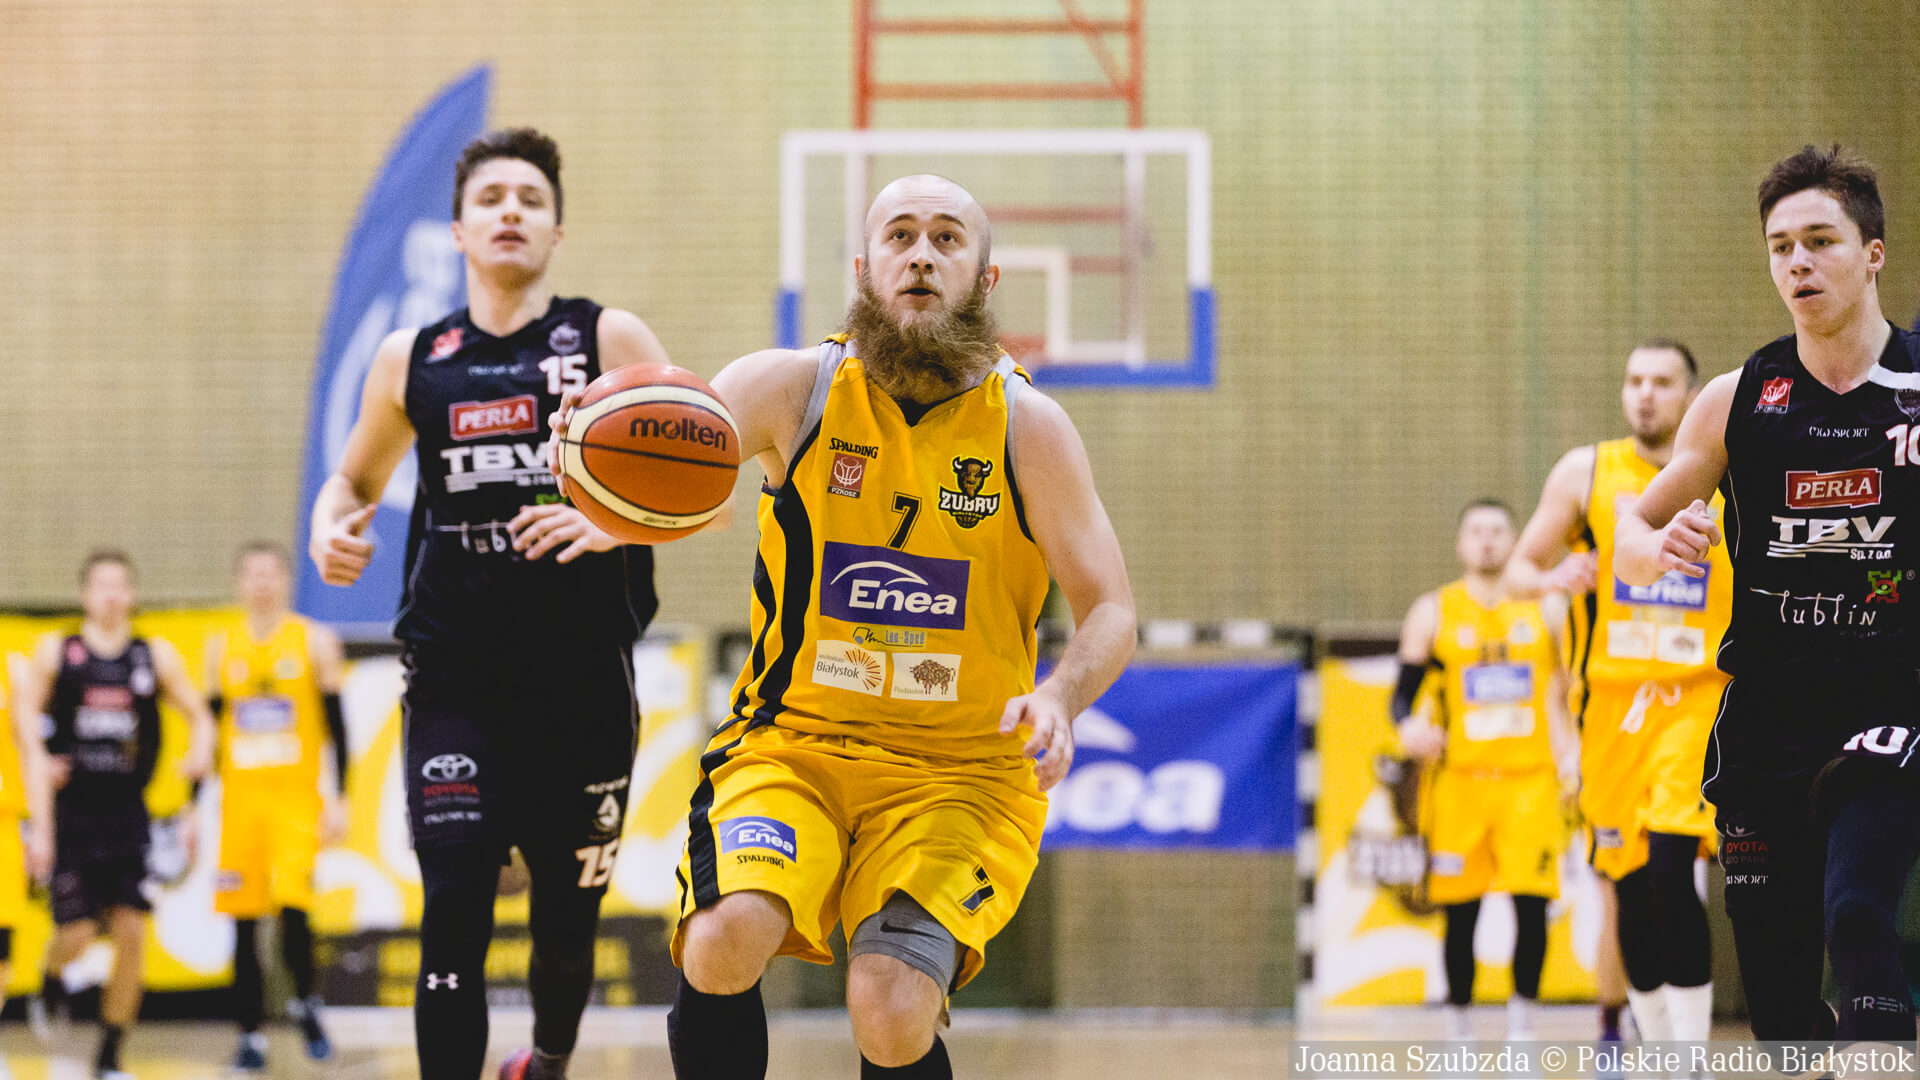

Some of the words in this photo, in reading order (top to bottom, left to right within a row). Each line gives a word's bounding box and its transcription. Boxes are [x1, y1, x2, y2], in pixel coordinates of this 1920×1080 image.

[538, 353, 588, 395] 15
[457, 403, 530, 432] PERŁA
[629, 417, 727, 452] molten
[829, 437, 880, 460] SPALDING
[440, 443, 550, 473] TBV
[940, 490, 998, 514] ZUBRY
[1795, 476, 1873, 500] PERŁA
[886, 491, 922, 552] 7
[1771, 515, 1896, 543] TBV
[848, 578, 957, 615] Enea
[816, 661, 860, 679] Białystok
[738, 828, 794, 855] Enea
[736, 854, 784, 870] SPALDING
